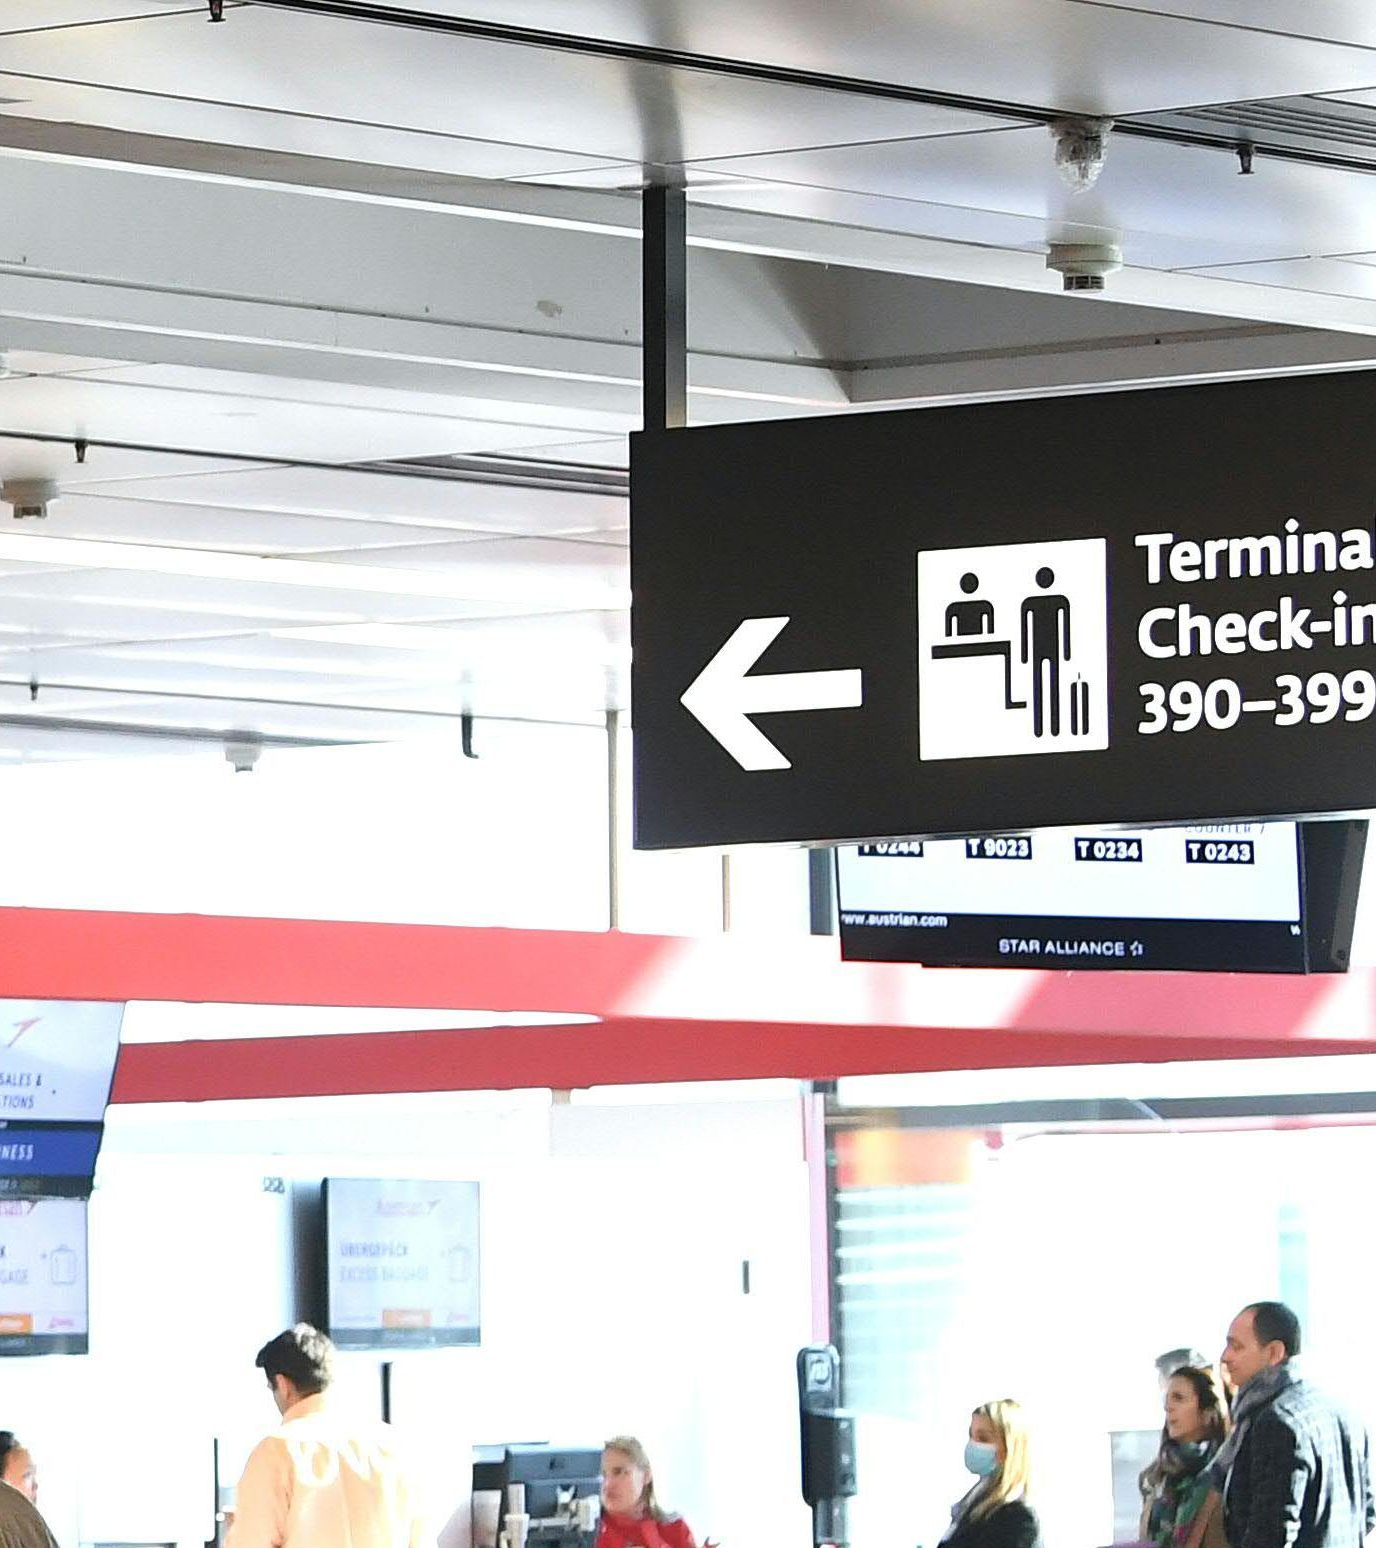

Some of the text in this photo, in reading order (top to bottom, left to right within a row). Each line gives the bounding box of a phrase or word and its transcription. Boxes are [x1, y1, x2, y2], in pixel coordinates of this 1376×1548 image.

[1134, 518, 1376, 584] Termina
[1137, 590, 1376, 659] Check-in
[969, 839, 1029, 858] T 9023
[1078, 840, 1139, 859] T 0234
[1188, 843, 1251, 861] T 0243
[999, 938, 1125, 957] STAR ALLIANCE
